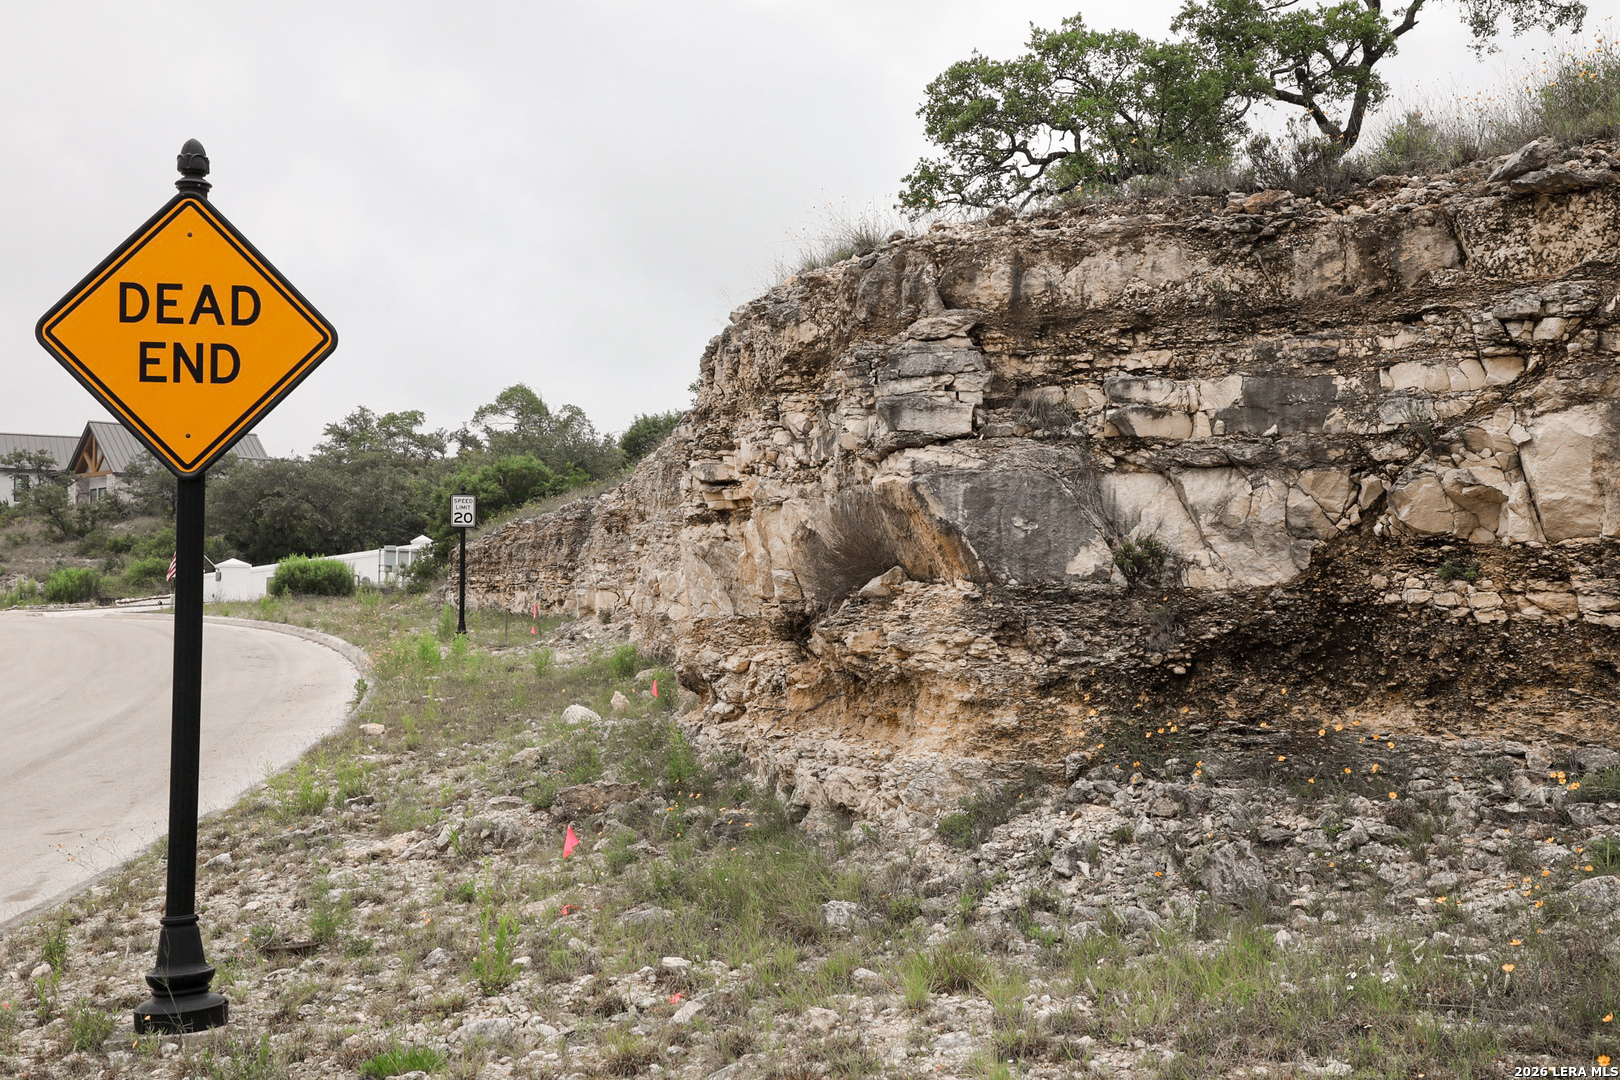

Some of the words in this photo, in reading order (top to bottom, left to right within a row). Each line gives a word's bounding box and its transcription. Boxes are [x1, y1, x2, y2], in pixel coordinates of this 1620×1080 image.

[119, 281, 262, 326] DEAD
[138, 341, 241, 384] END
[454, 512, 473, 523] 20
